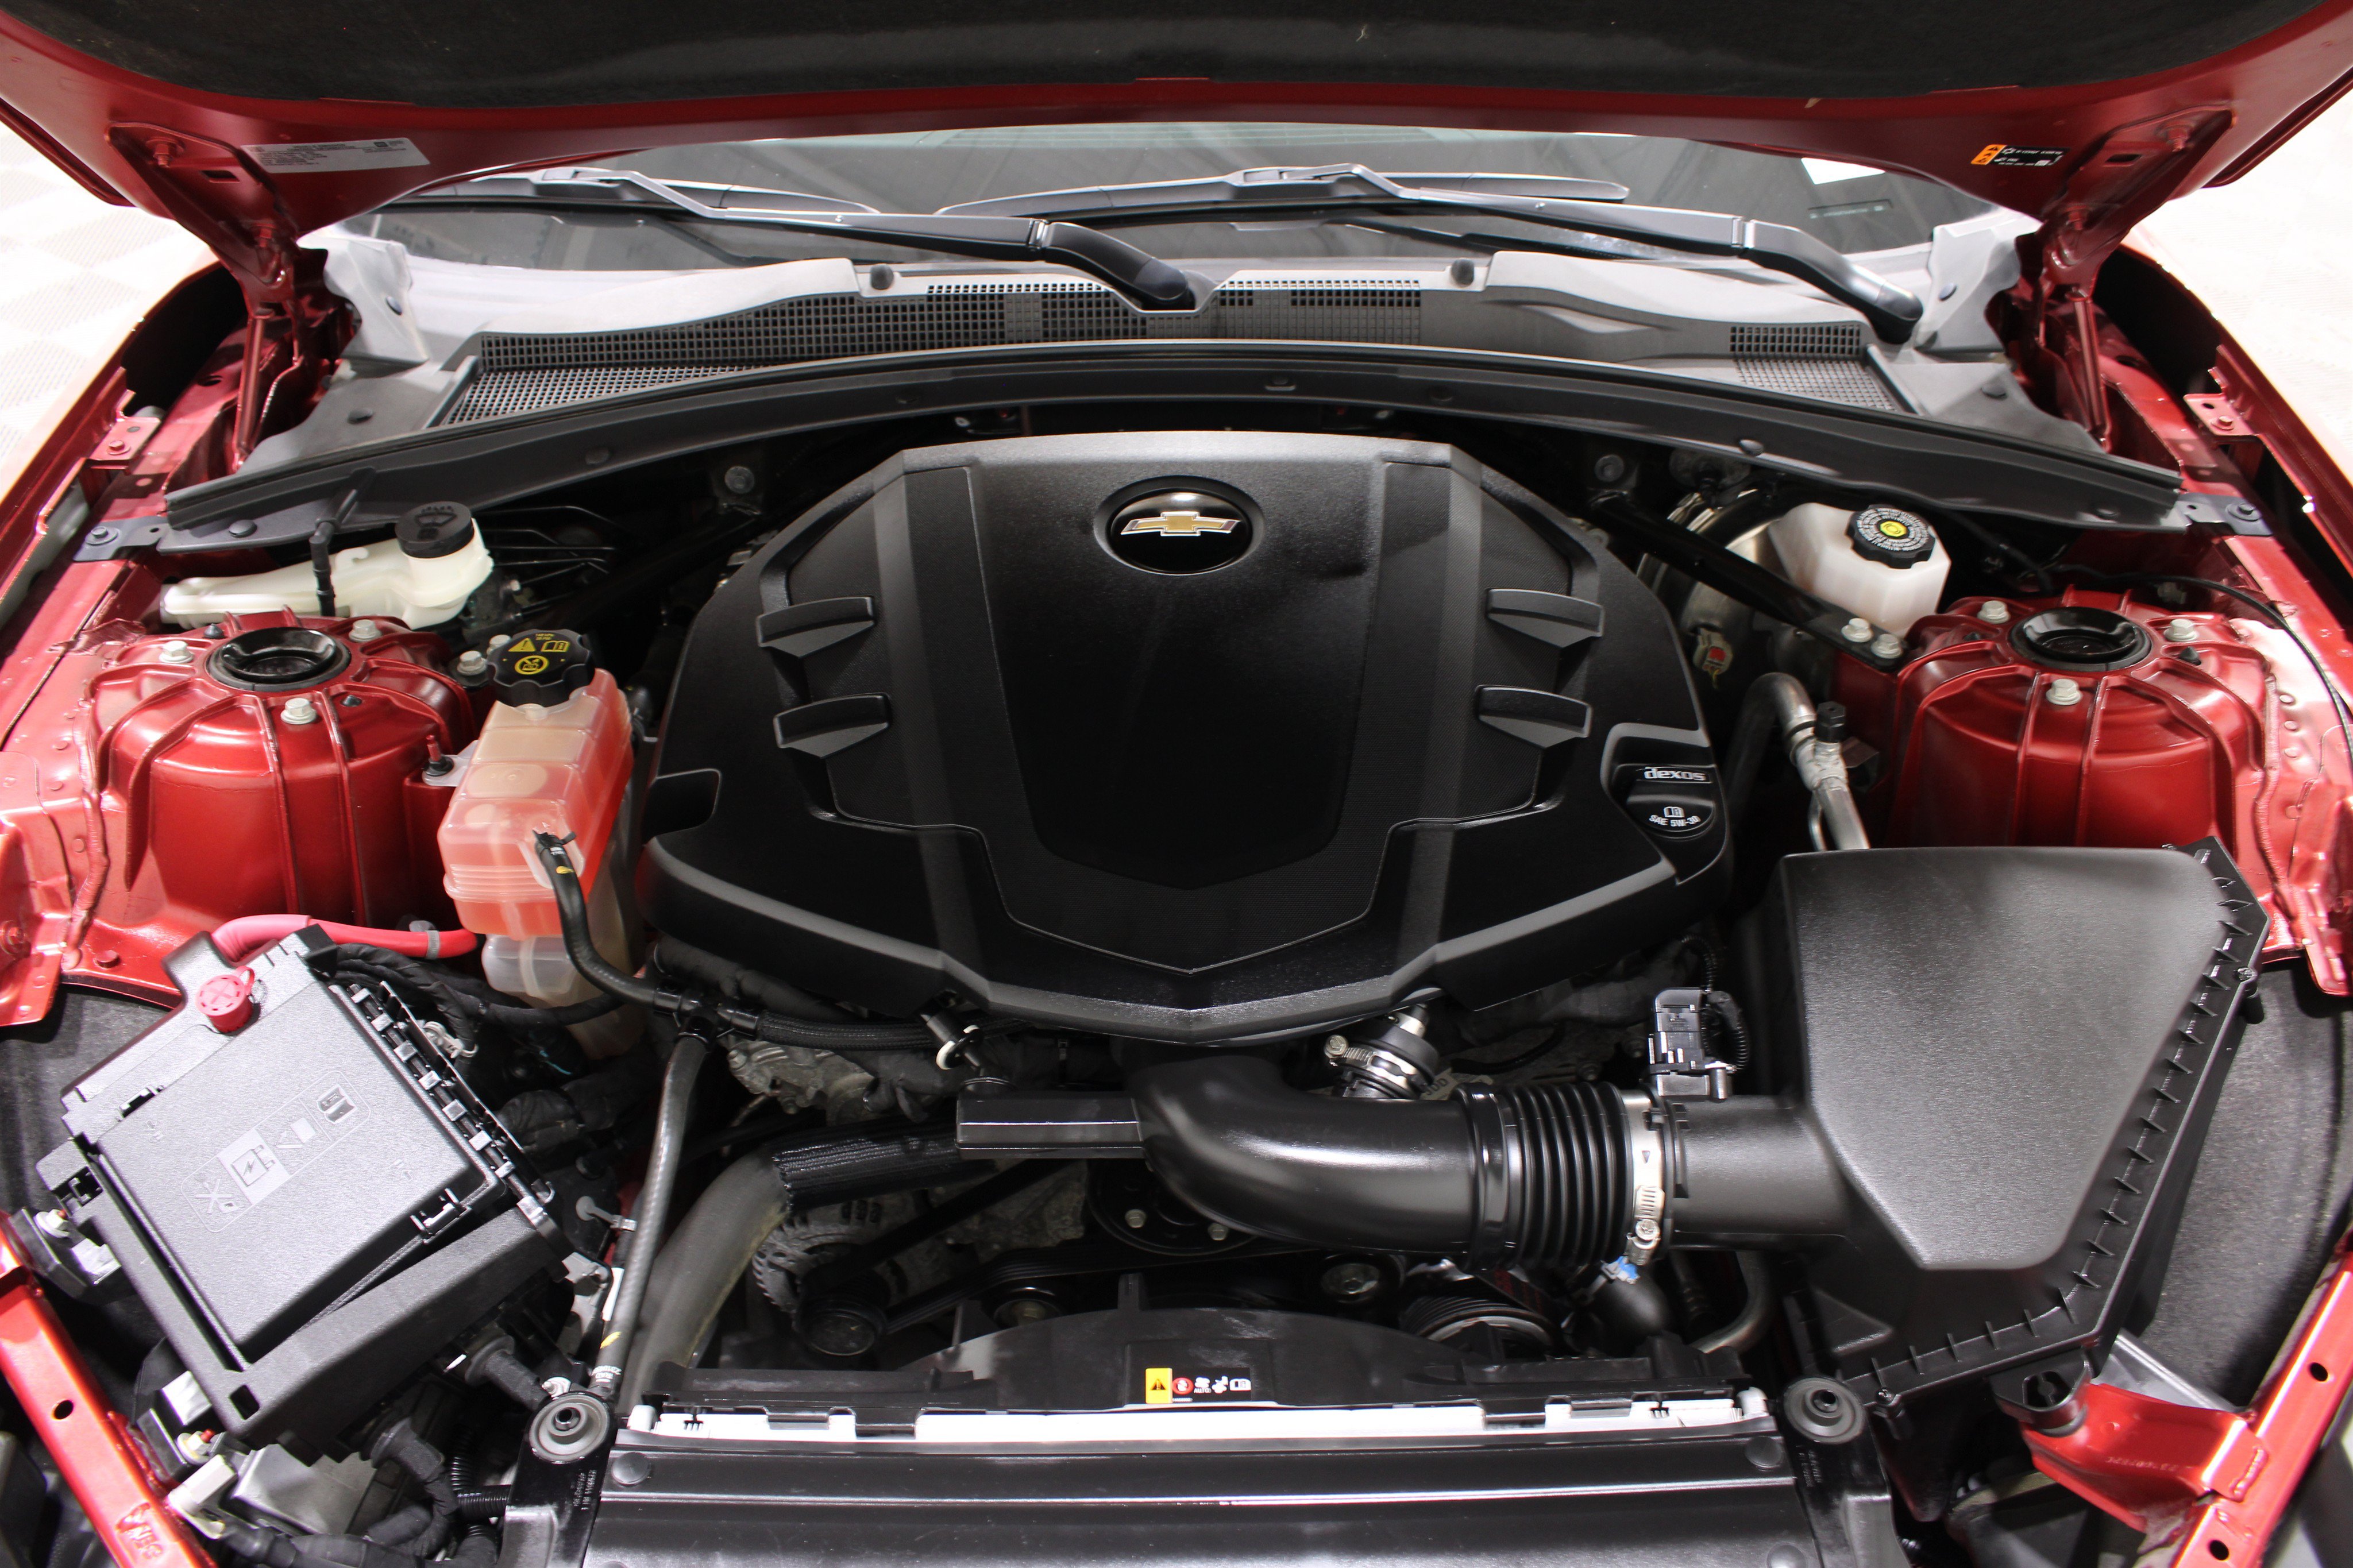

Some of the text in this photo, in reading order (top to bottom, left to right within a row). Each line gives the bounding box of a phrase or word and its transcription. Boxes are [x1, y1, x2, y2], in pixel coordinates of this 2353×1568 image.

[1644, 767, 1706, 781] dexos
[1649, 814, 1701, 827] SAE 5W-30
